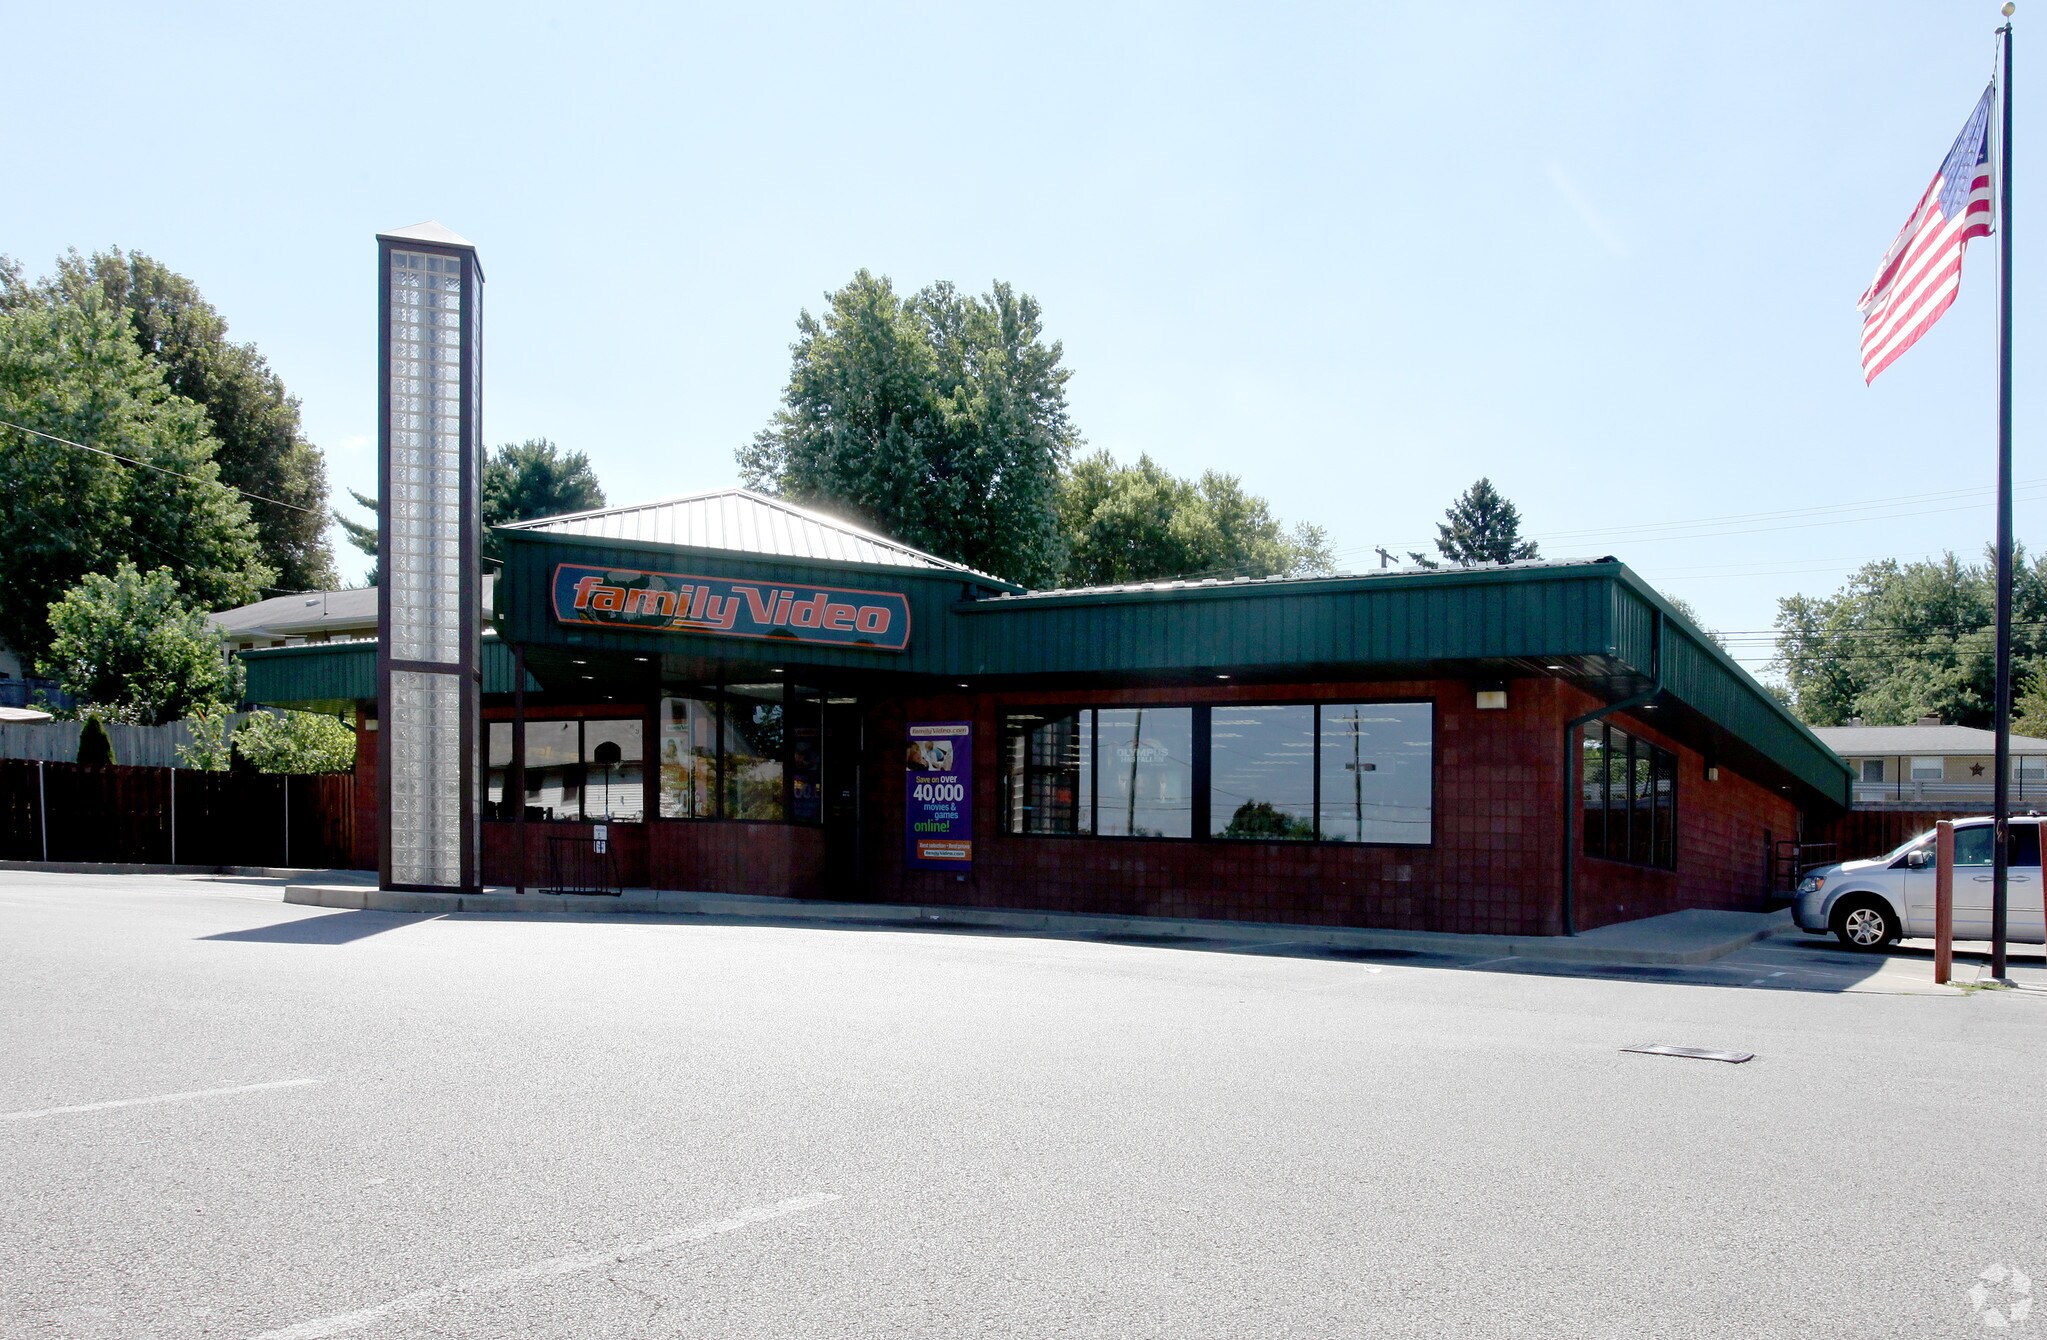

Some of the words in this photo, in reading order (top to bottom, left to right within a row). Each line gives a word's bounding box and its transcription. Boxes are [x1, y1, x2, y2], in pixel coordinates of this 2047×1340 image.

[940, 775, 957, 783] over
[913, 784, 963, 803] 40,000
[924, 803, 949, 811] movies
[950, 802, 957, 811] &
[934, 812, 959, 820] games
[914, 820, 950, 832] online!
